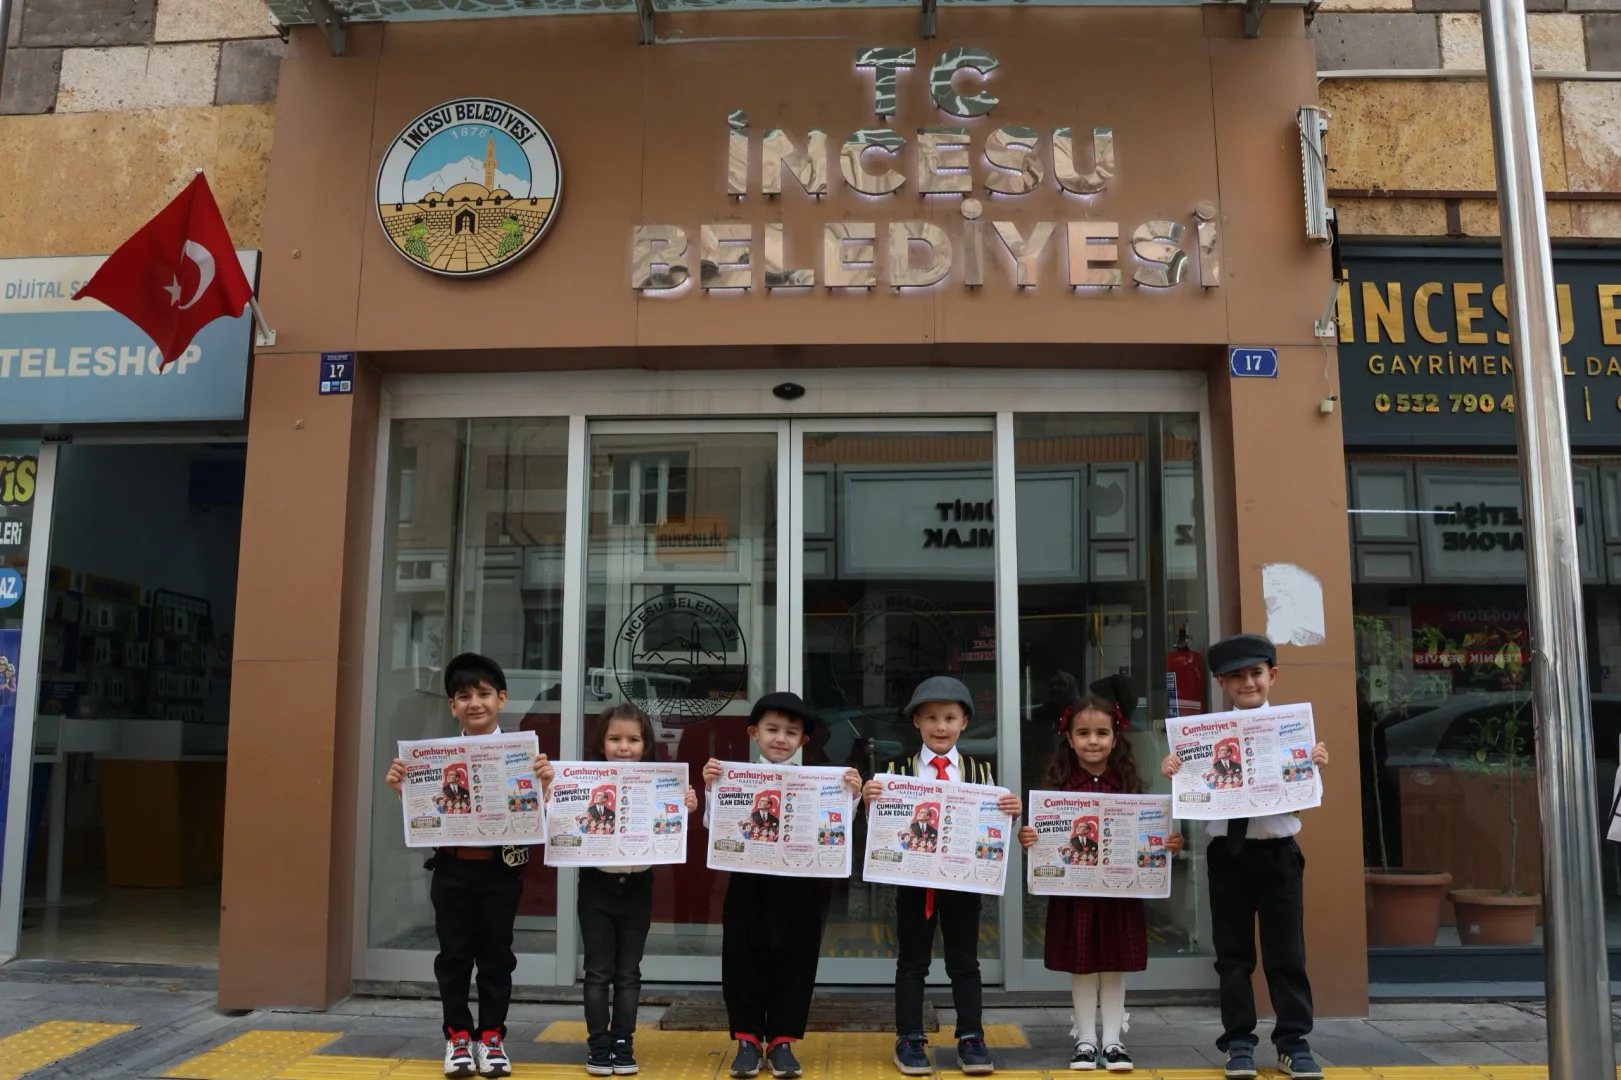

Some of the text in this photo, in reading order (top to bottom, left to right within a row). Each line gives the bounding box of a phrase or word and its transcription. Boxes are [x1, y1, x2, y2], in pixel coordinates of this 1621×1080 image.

[855, 47, 1000, 117] TC
[401, 103, 537, 150] İNCESU BELEDİYESİ
[452, 127, 487, 139] 1876
[727, 109, 1115, 198] İNCESU
[632, 199, 1221, 291] BELEDİYESİ
[5, 279, 65, 299] DİJİTAL
[1245, 355, 1262, 371] 17
[329, 364, 345, 379] 17
[1396, 393, 1440, 413] 532
[621, 597, 739, 642] İNCESU BELEDİYESİ
[1181, 722, 1229, 736] Cumhuriyet
[412, 747, 458, 759] Cumhuriyet
[1176, 744, 1213, 757] CUMHURİYET
[407, 768, 442, 779] CUMHURİYET
[563, 767, 610, 778] Cumhuriyet
[727, 769, 774, 782] Cumhuriyet
[554, 788, 590, 797] CUMHURİYET
[887, 781, 934, 794] Cumhuriyet
[717, 791, 754, 800] CUMHURİYET
[1043, 797, 1091, 808] Cumhuriyet
[1034, 819, 1073, 828] CUMHURİYET
